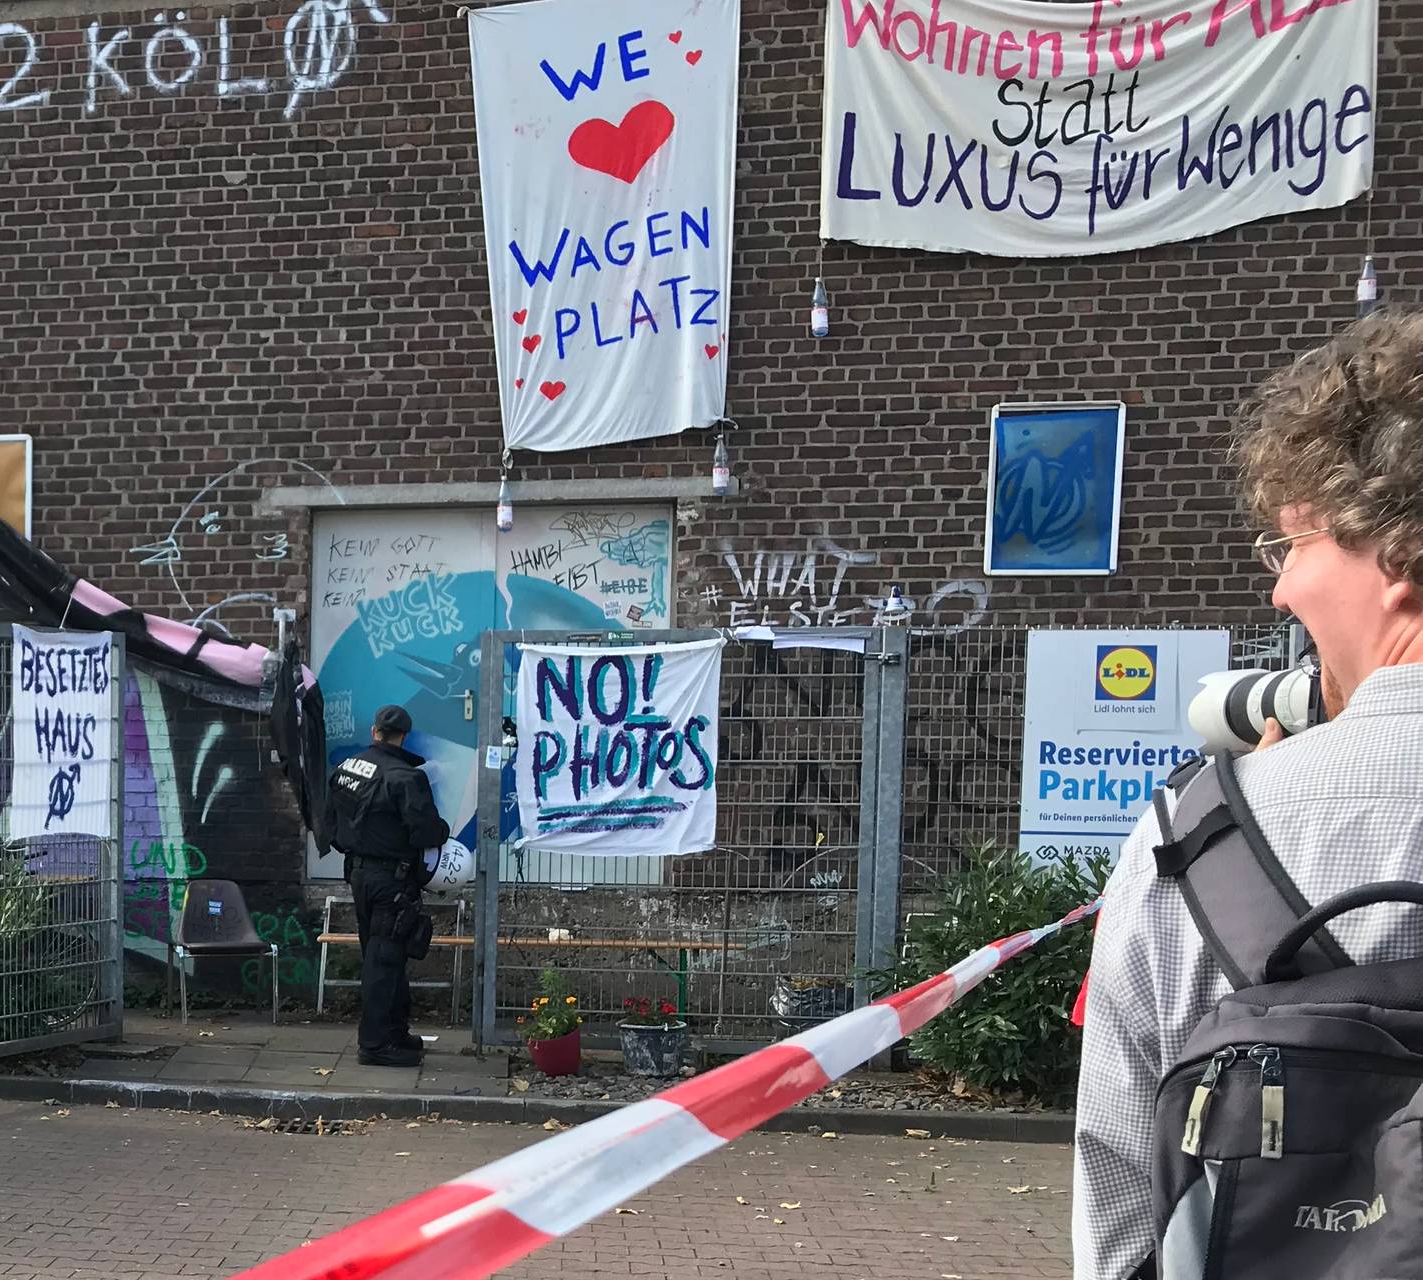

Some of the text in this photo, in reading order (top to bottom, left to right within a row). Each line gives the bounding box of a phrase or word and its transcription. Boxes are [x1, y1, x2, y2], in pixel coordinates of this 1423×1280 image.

[538, 30, 651, 101] WE
[840, 0, 1064, 80] Wohnen
[1079, 0, 1192, 78] für
[991, 70, 1150, 150] Statt
[836, 84, 1371, 237] LUXUS für Wenige
[508, 206, 711, 288] WAGEN
[554, 275, 721, 360] PLATZ
[327, 562, 448, 584] KEIN STAAT
[329, 533, 441, 562] KEIN GOTT
[510, 539, 562, 577] HAMBI
[322, 587, 366, 608] KEIN
[357, 571, 457, 632] KUCK
[368, 605, 464, 659] KUCK
[20, 638, 109, 698] BESETZTES
[536, 654, 663, 727] NO!
[35, 706, 96, 763] HAUS
[1094, 704, 1156, 714] Lidl lohnt sich
[532, 714, 715, 808] PHOTOS
[1039, 740, 1204, 767] Reservierte
[1038, 769, 1168, 810] Parkpl
[1039, 813, 1138, 823] für Deinen persönlichen
[1063, 845, 1111, 856] MAZDA
